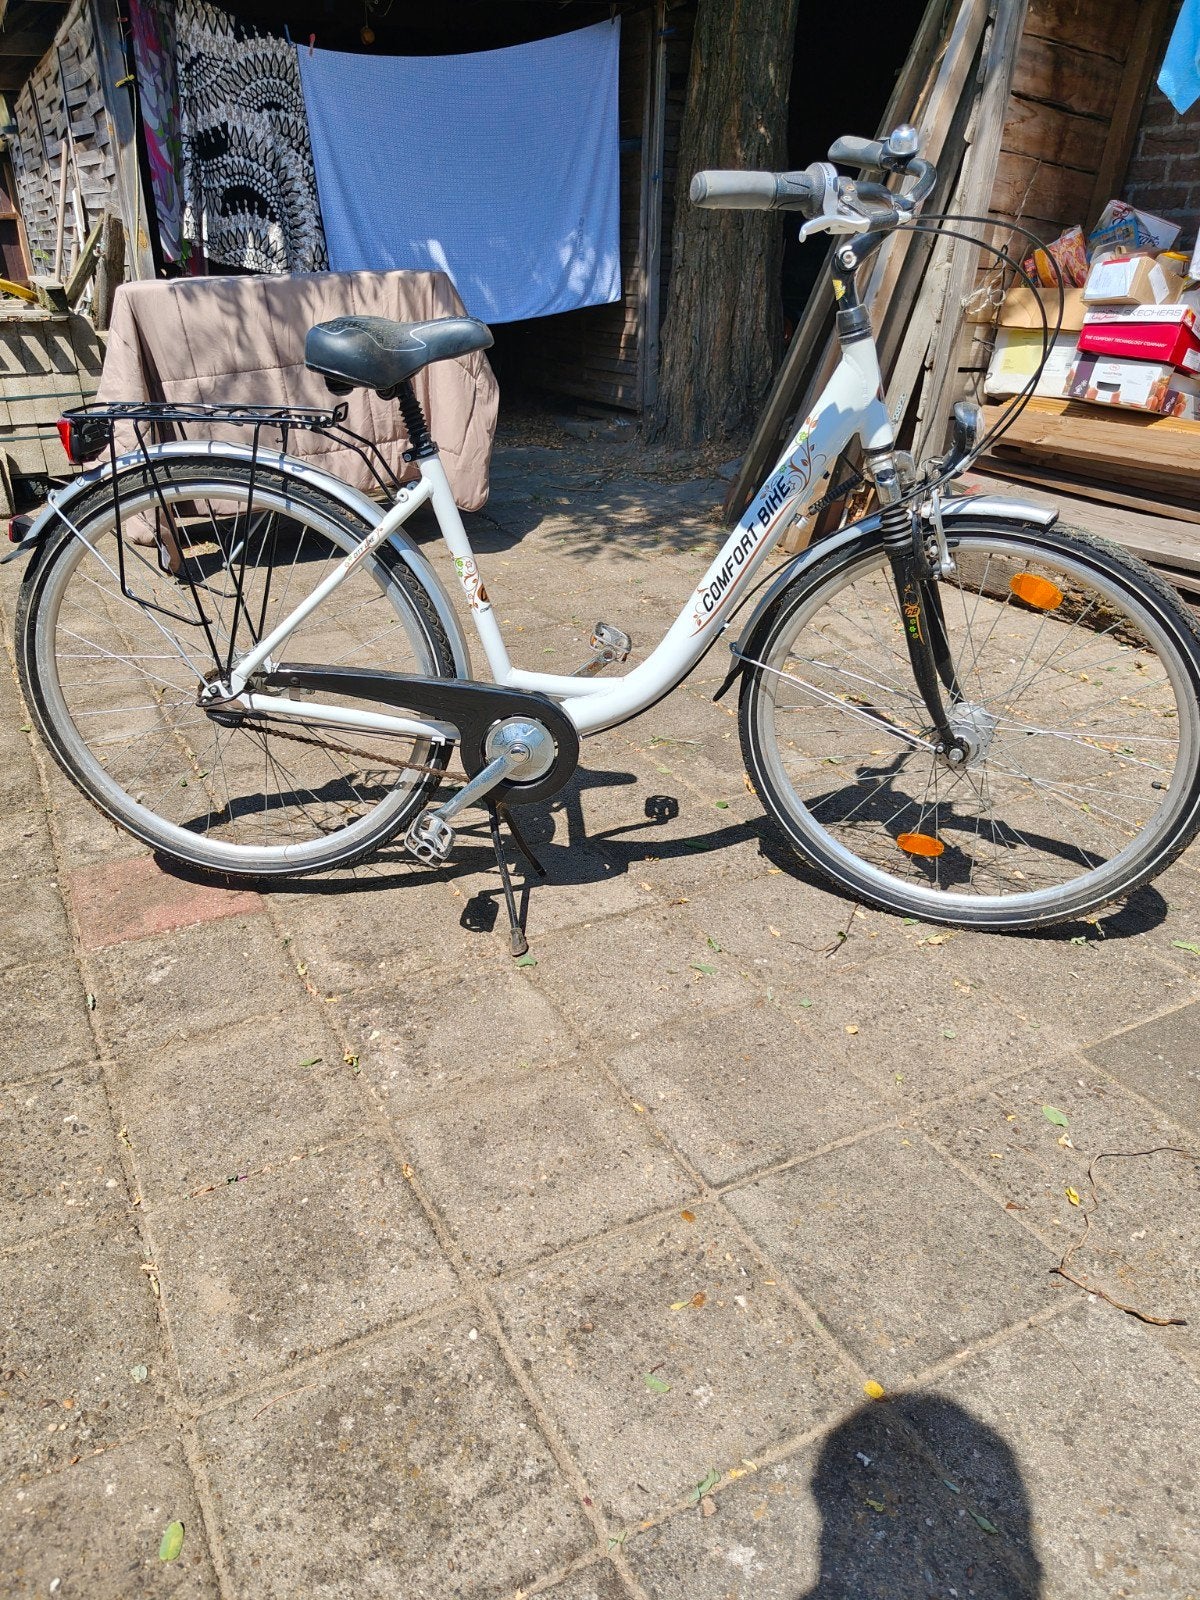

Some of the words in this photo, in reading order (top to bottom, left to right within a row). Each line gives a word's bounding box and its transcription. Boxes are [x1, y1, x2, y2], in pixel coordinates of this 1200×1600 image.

[1123, 309, 1183, 317] SKECHERS
[1093, 335, 1114, 343] COMFORT
[1115, 337, 1143, 346] TECHNOLOGY
[702, 522, 759, 612] COMFORT
[757, 475, 791, 529] BIKE
